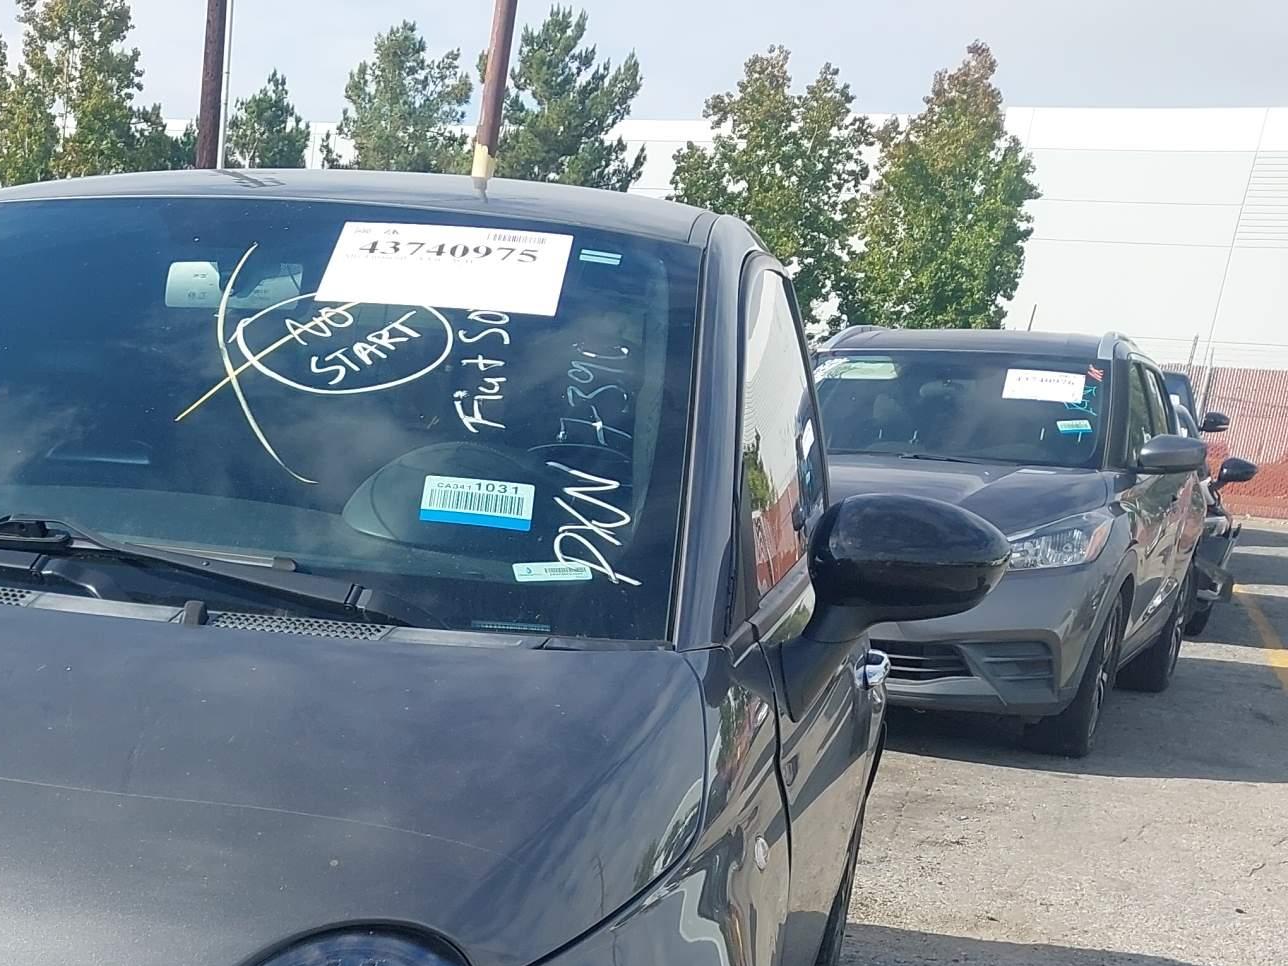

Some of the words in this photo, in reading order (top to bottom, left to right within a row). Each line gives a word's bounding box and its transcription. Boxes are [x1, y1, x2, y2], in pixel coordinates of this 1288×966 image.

[359, 240, 539, 263] 43740975
[458, 308, 511, 345] 50
[311, 310, 421, 385] START
